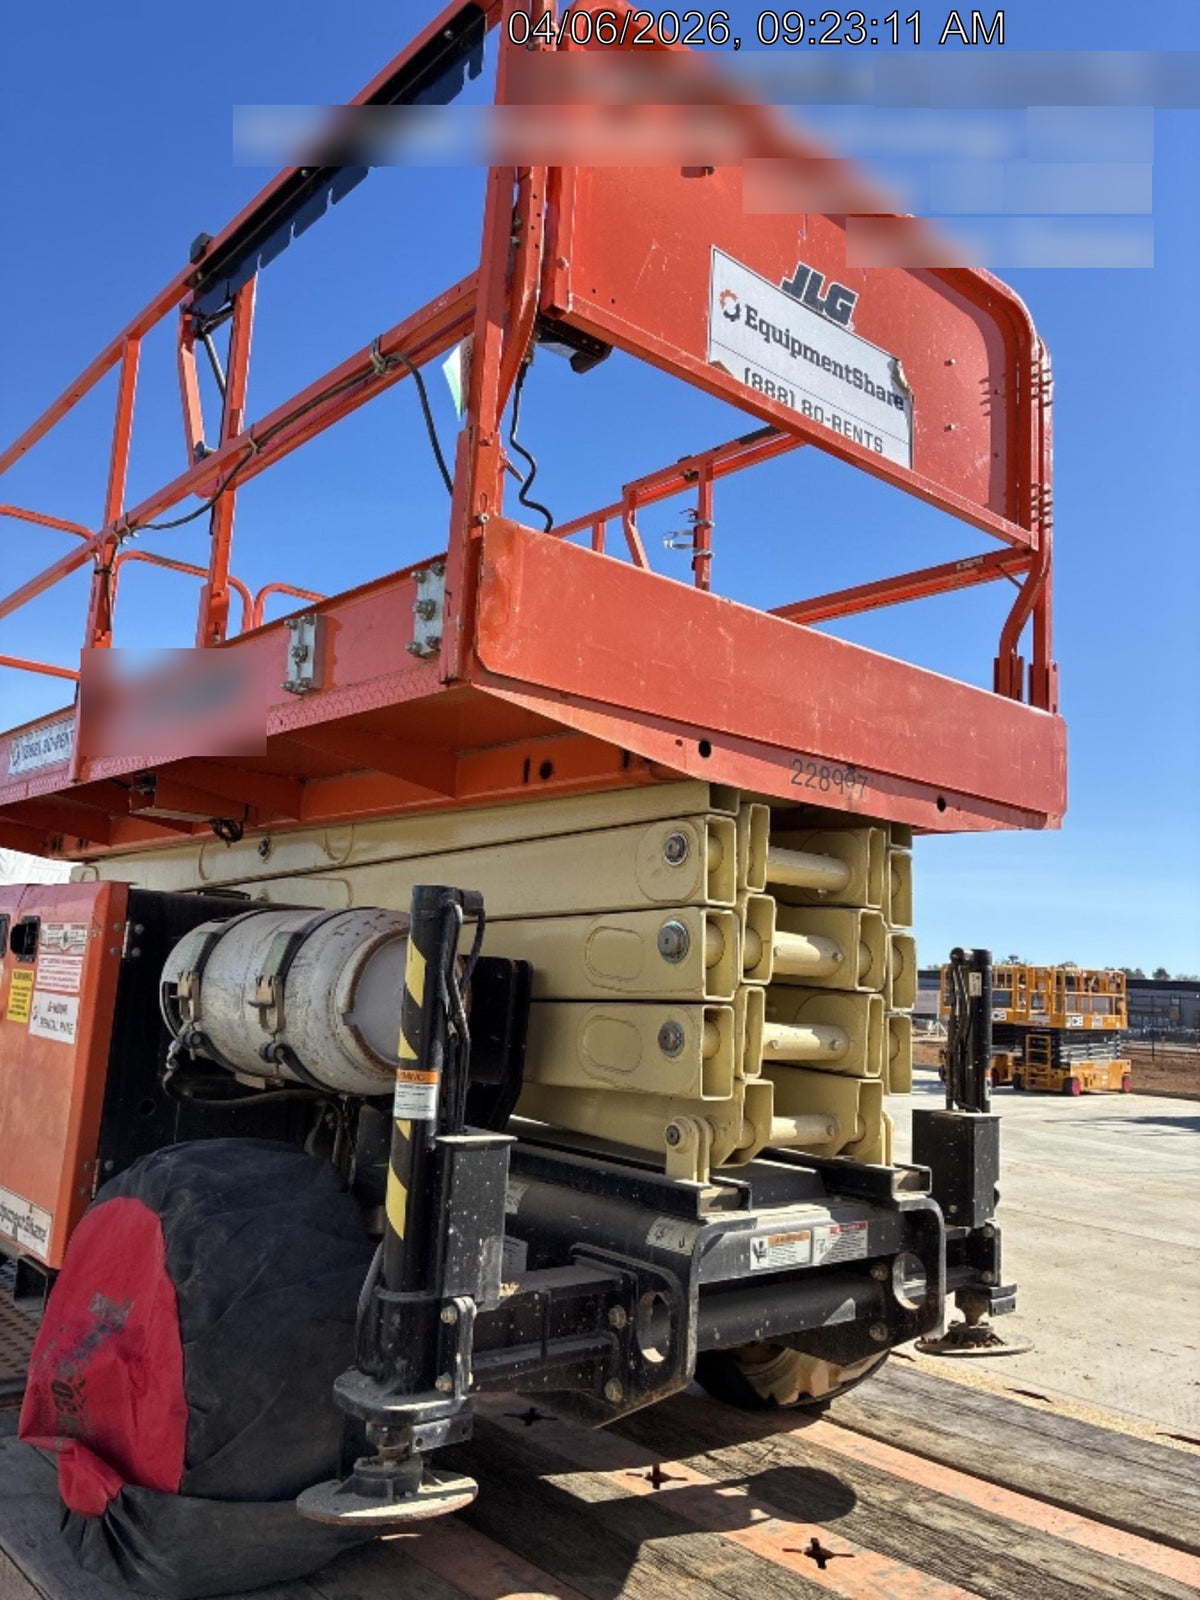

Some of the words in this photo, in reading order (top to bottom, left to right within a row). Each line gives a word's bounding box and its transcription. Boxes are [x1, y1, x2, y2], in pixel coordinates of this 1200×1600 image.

[779, 261, 859, 329] JLG
[744, 303, 904, 411] EquipmentShare
[801, 399, 884, 455] 80-RENTS
